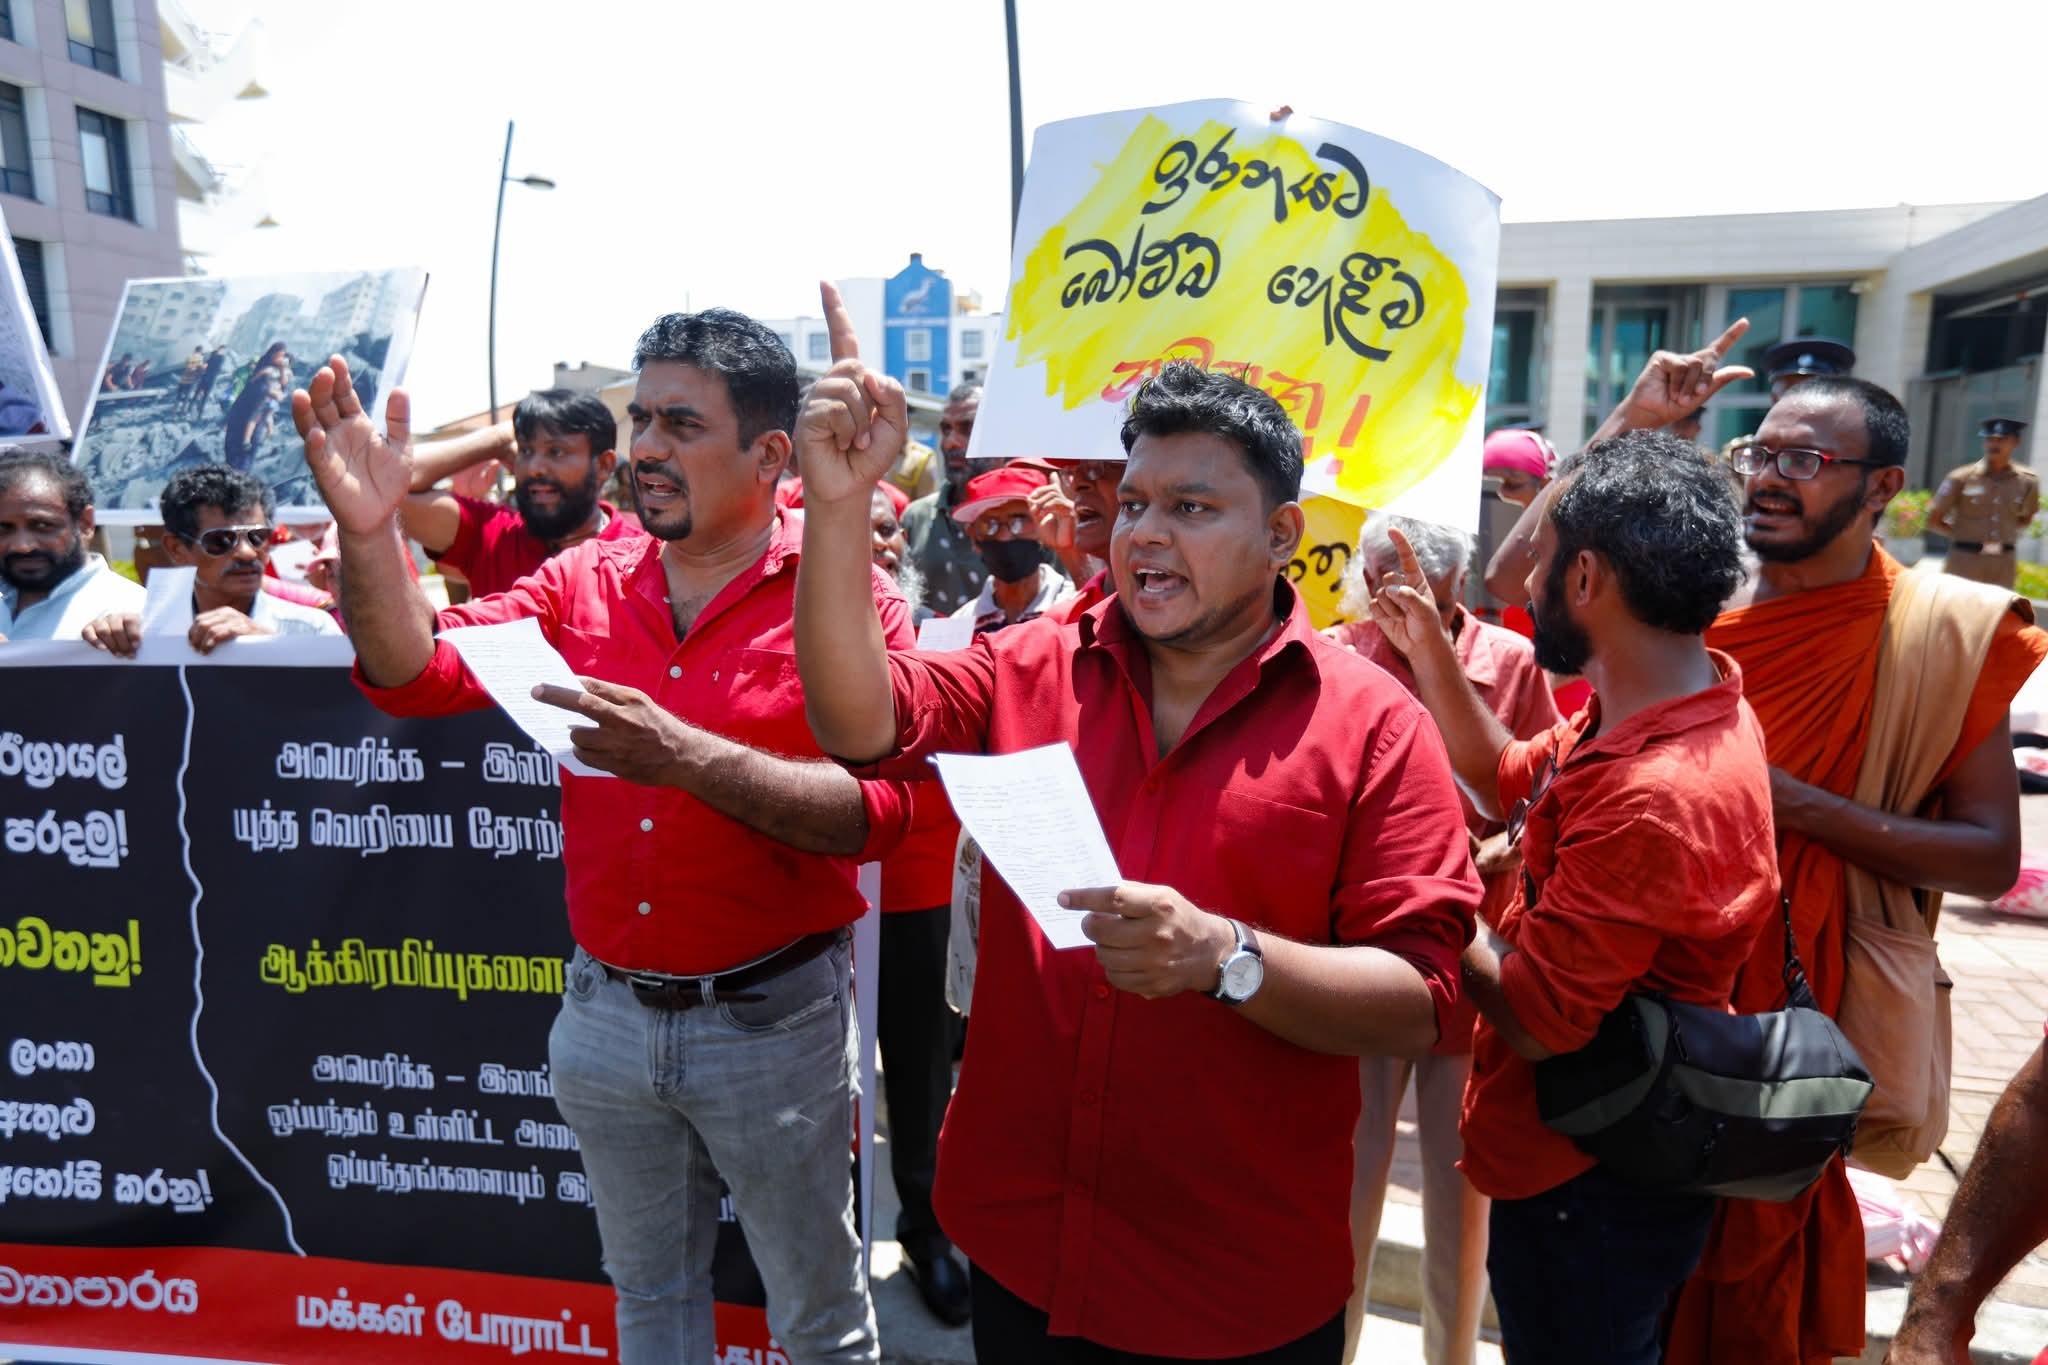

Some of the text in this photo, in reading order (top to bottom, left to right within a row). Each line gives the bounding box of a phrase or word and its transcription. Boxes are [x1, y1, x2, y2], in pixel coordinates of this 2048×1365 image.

[276, 737, 425, 787] அமெரிக்க
[483, 742, 561, 787] இஸ்
[4, 808, 129, 867] පරදමු!
[233, 799, 565, 861] யுத்த வெறியை தோற்
[10, 1038, 95, 1075] ලංකා
[313, 1053, 434, 1090] அமெரிக்க
[267, 1098, 378, 1139] ஒப்பந்தம்
[388, 1108, 504, 1146] உள்ளிட்ட
[115, 1168, 213, 1213] කරනු!
[327, 1150, 545, 1205] ஒப்பந்தங்களையும்
[297, 1287, 424, 1336] மக்கள்
[436, 1299, 608, 1357] போராட்ட
